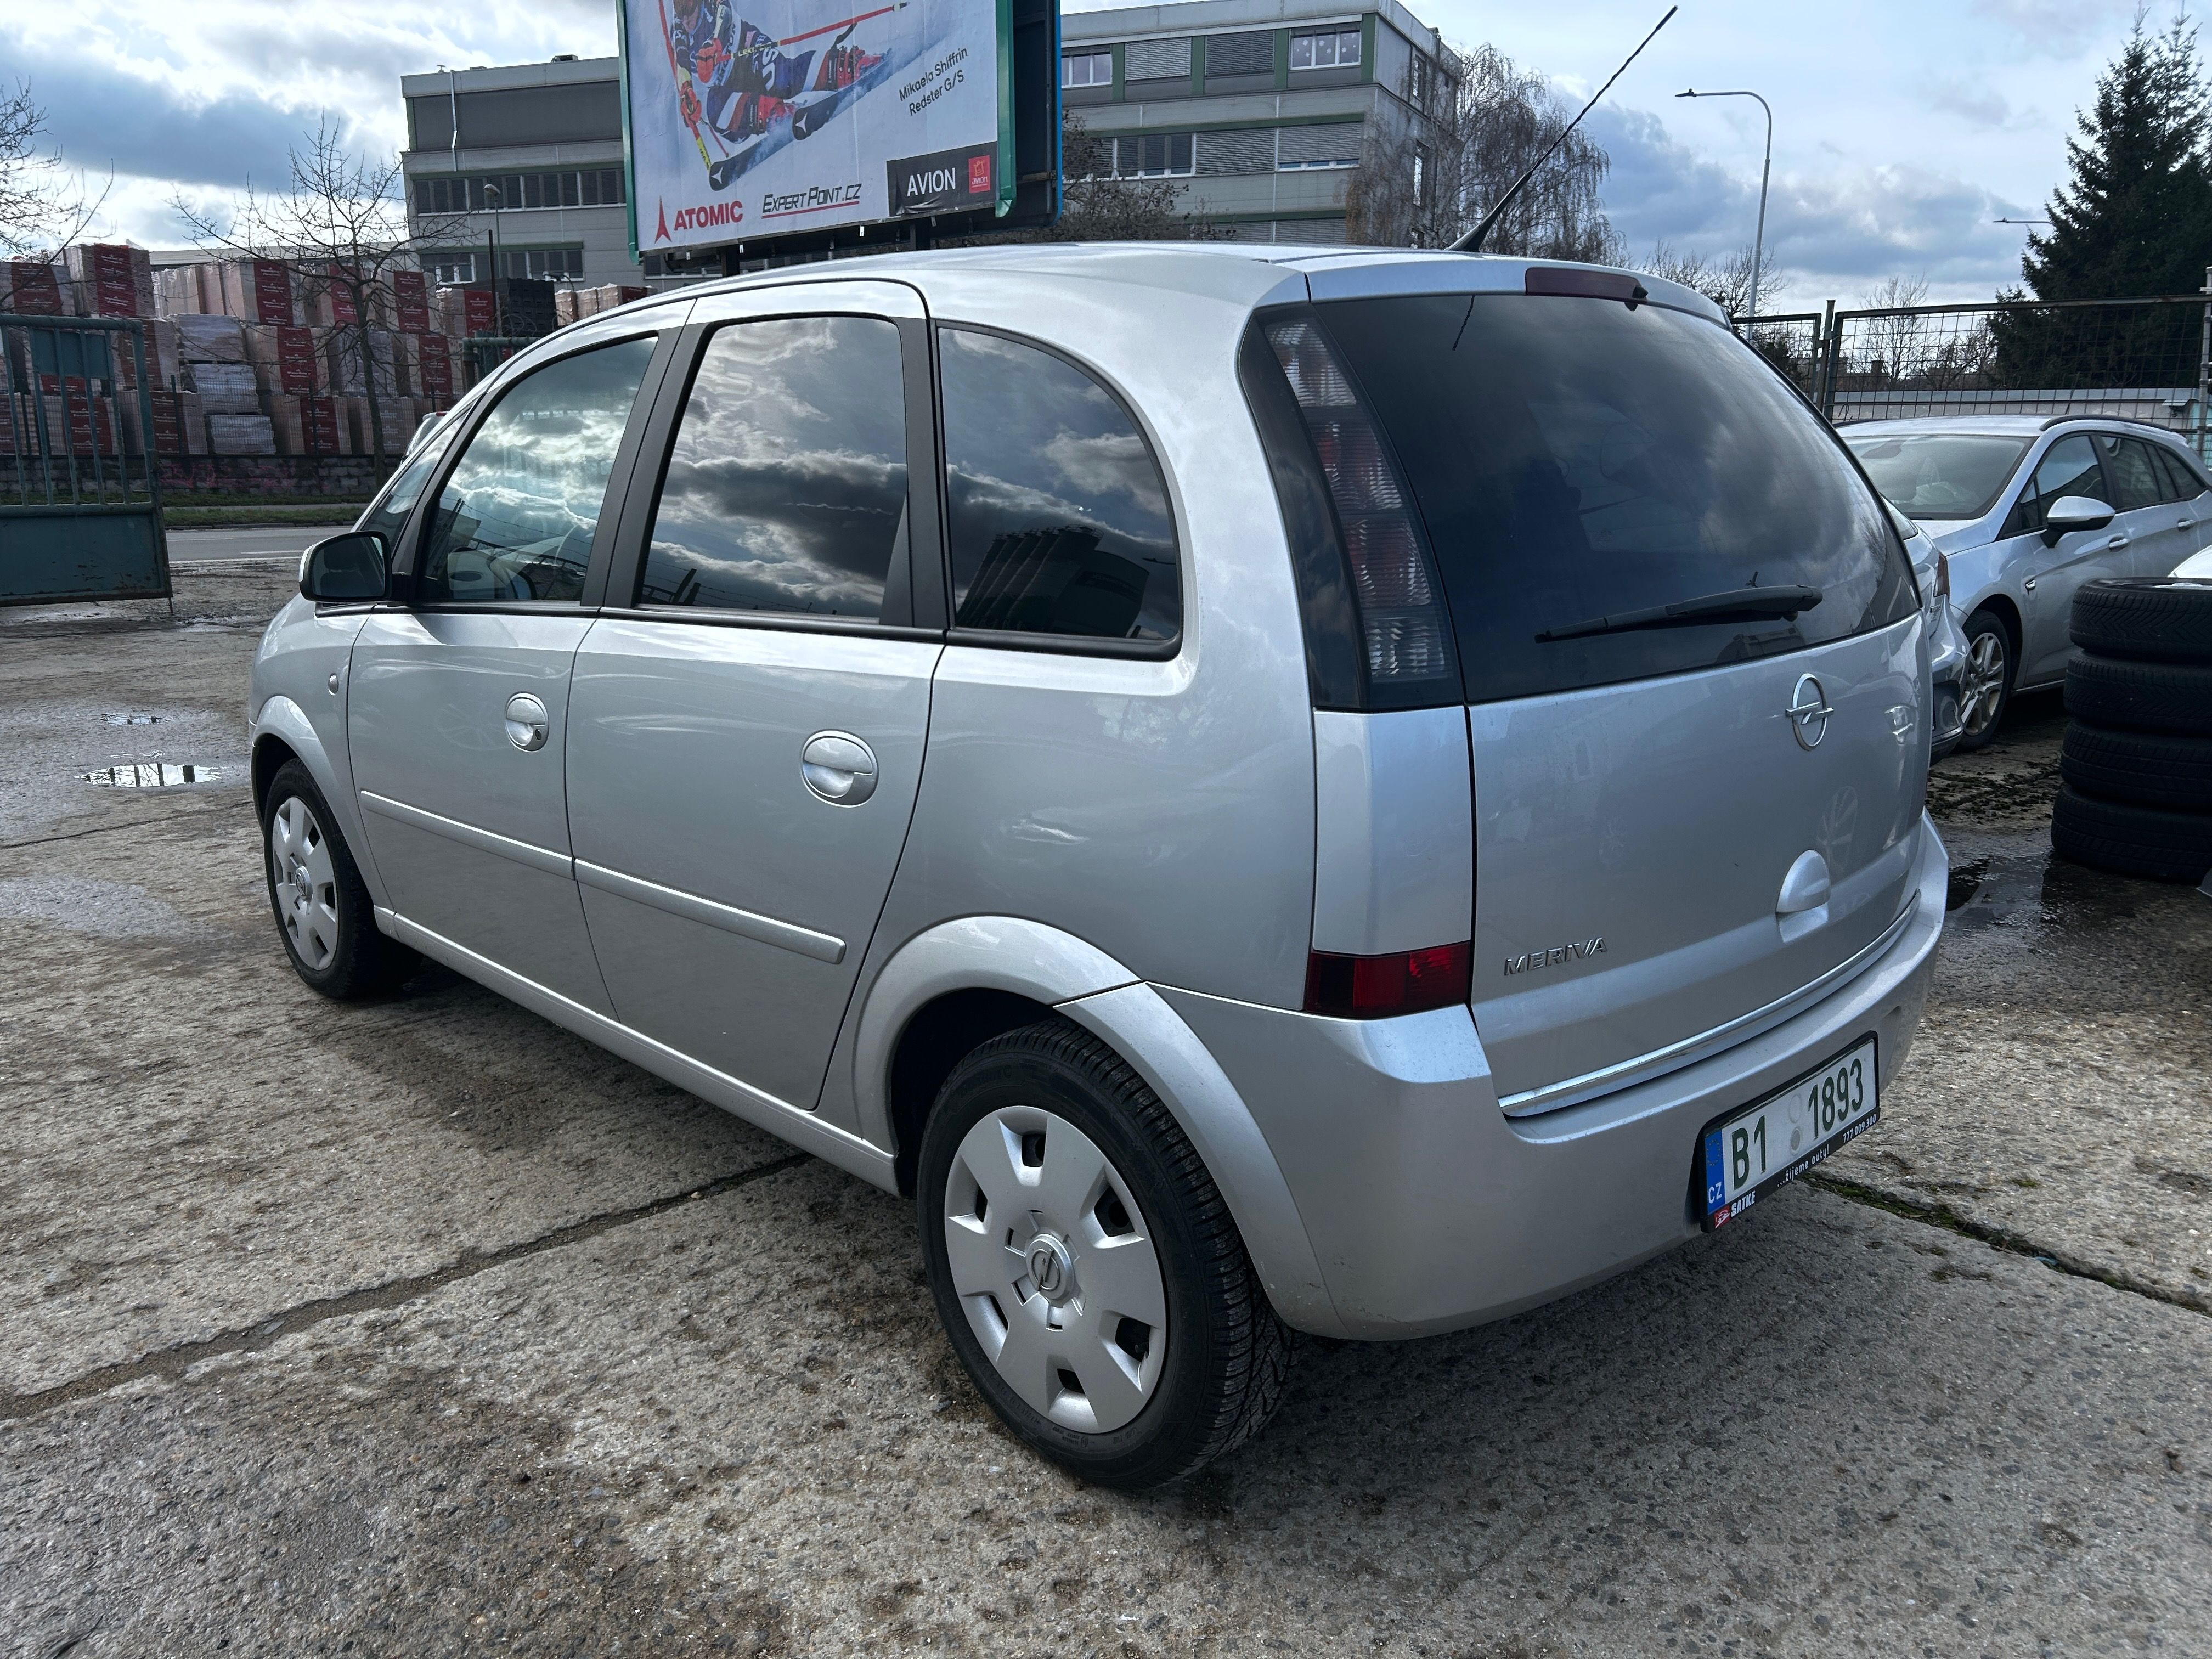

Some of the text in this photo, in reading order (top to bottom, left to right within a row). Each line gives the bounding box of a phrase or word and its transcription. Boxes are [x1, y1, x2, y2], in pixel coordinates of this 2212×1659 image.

[899, 48, 968, 101] Mikaela Shiffrin
[909, 70, 964, 116] Redster G/S
[907, 167, 956, 197] AVION
[674, 200, 743, 231] ATOMIC
[1504, 937, 1607, 976] MERIVA
[1731, 1058, 1863, 1191] B1 1893
[1843, 1128, 1853, 1143] 777
[1854, 1121, 1865, 1136] 009
[1866, 1114, 1876, 1128] 300
[1708, 1182, 1722, 1204] CZ
